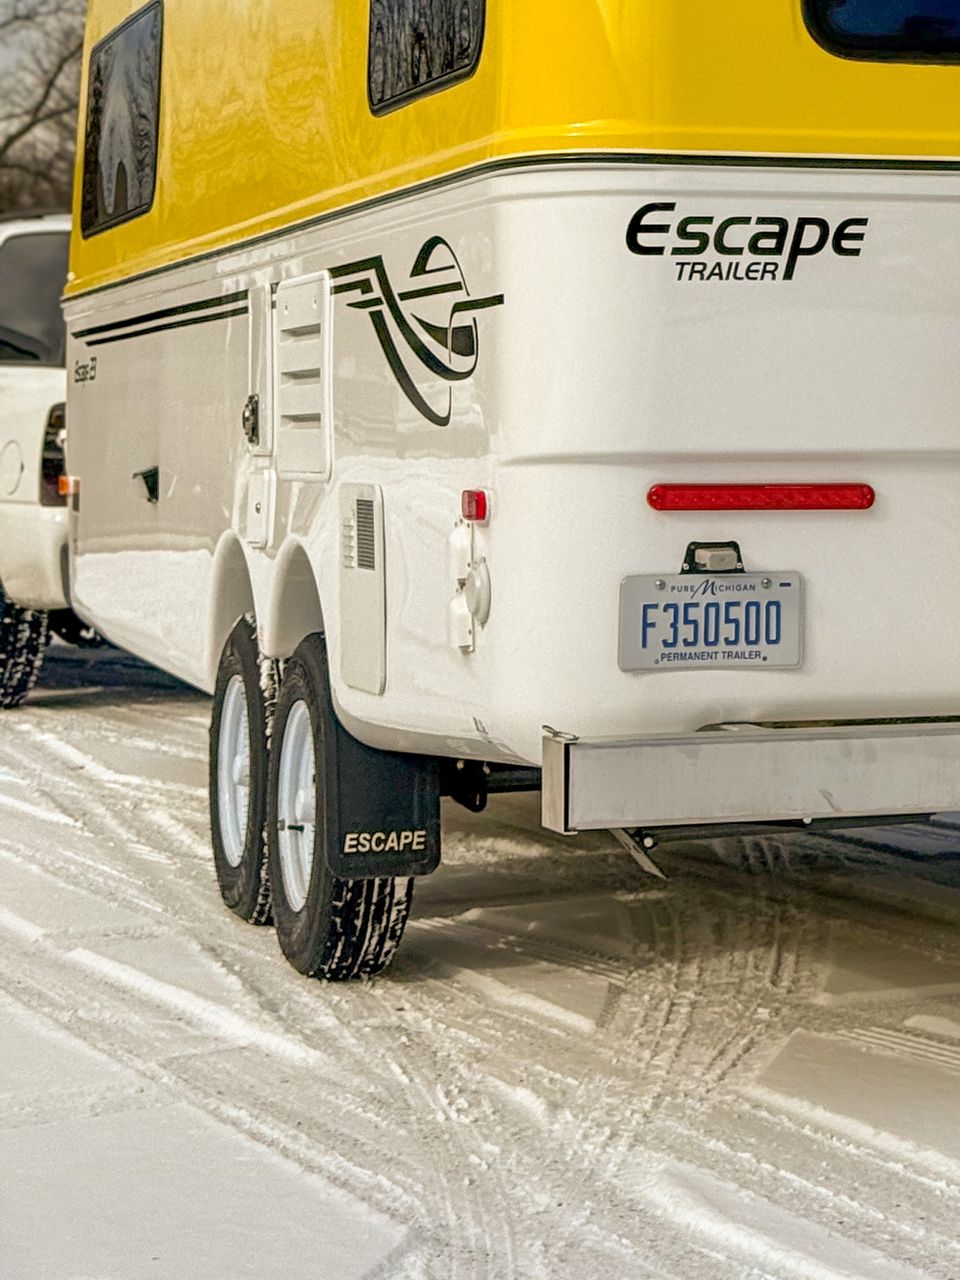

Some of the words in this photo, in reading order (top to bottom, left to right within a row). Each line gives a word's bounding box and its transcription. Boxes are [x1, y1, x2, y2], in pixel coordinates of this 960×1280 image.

[625, 202, 869, 280] Escape
[675, 261, 779, 281] TRAILER
[670, 584, 695, 593] PURE
[690, 578, 756, 599] MICHIGAN
[641, 600, 782, 649] F350500
[660, 651, 719, 662] PERMANENT
[721, 650, 762, 661] TRAILER
[343, 829, 427, 854] ESCAPE
